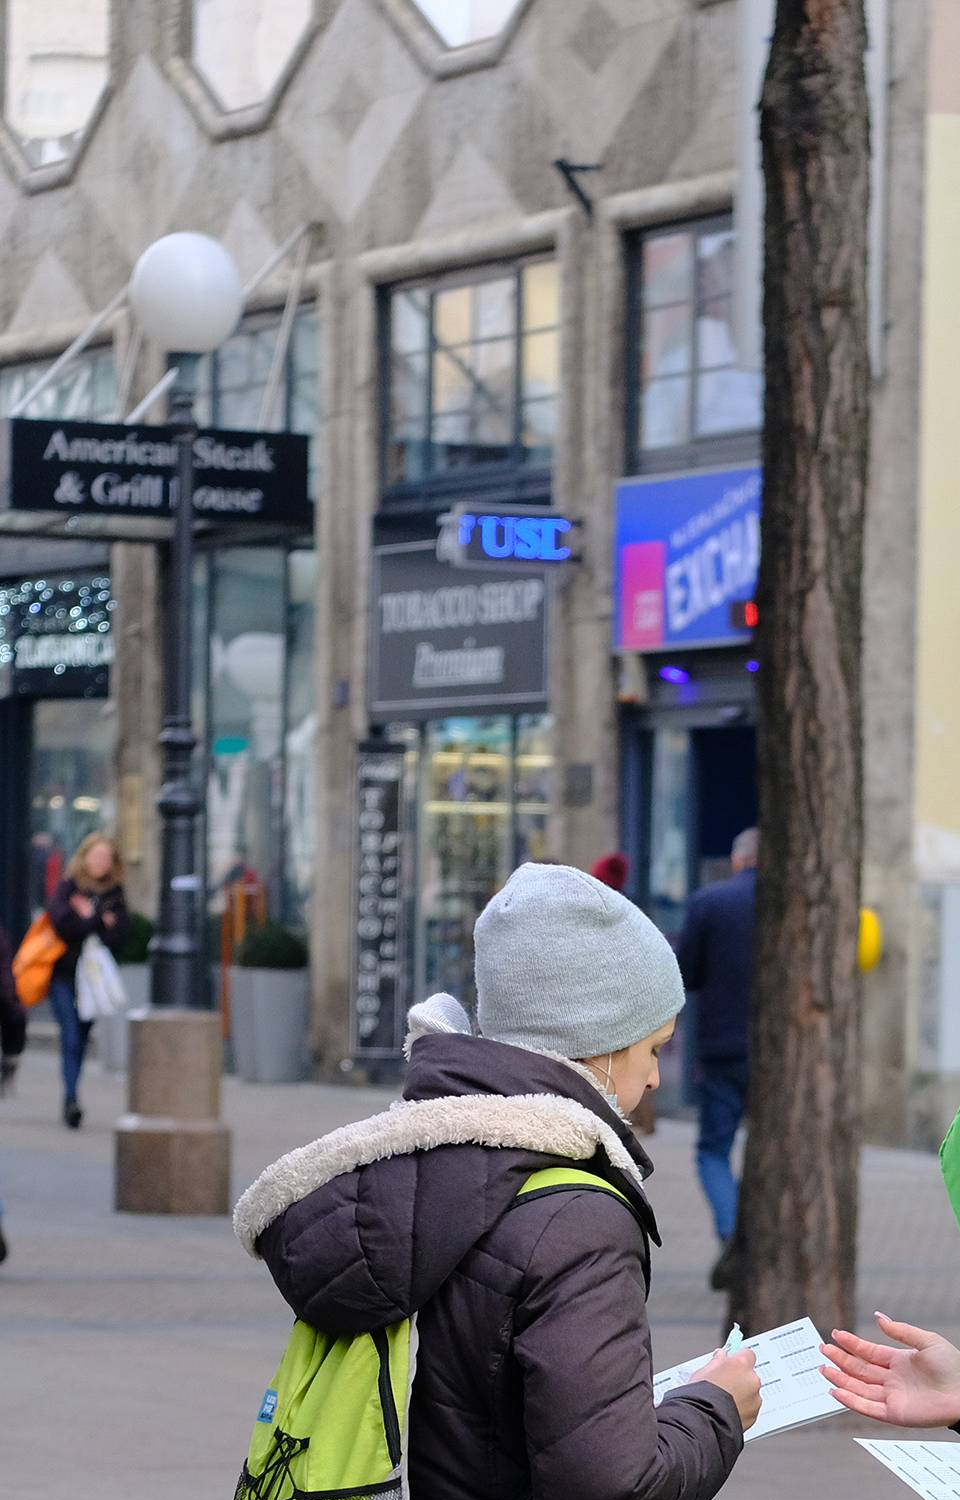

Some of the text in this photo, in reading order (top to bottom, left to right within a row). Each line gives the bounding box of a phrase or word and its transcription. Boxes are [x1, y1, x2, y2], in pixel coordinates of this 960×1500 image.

[192, 436, 275, 472] Steak
[54, 471, 84, 504] &
[91, 471, 164, 507] Grill
[479, 579, 544, 625] SHOP
